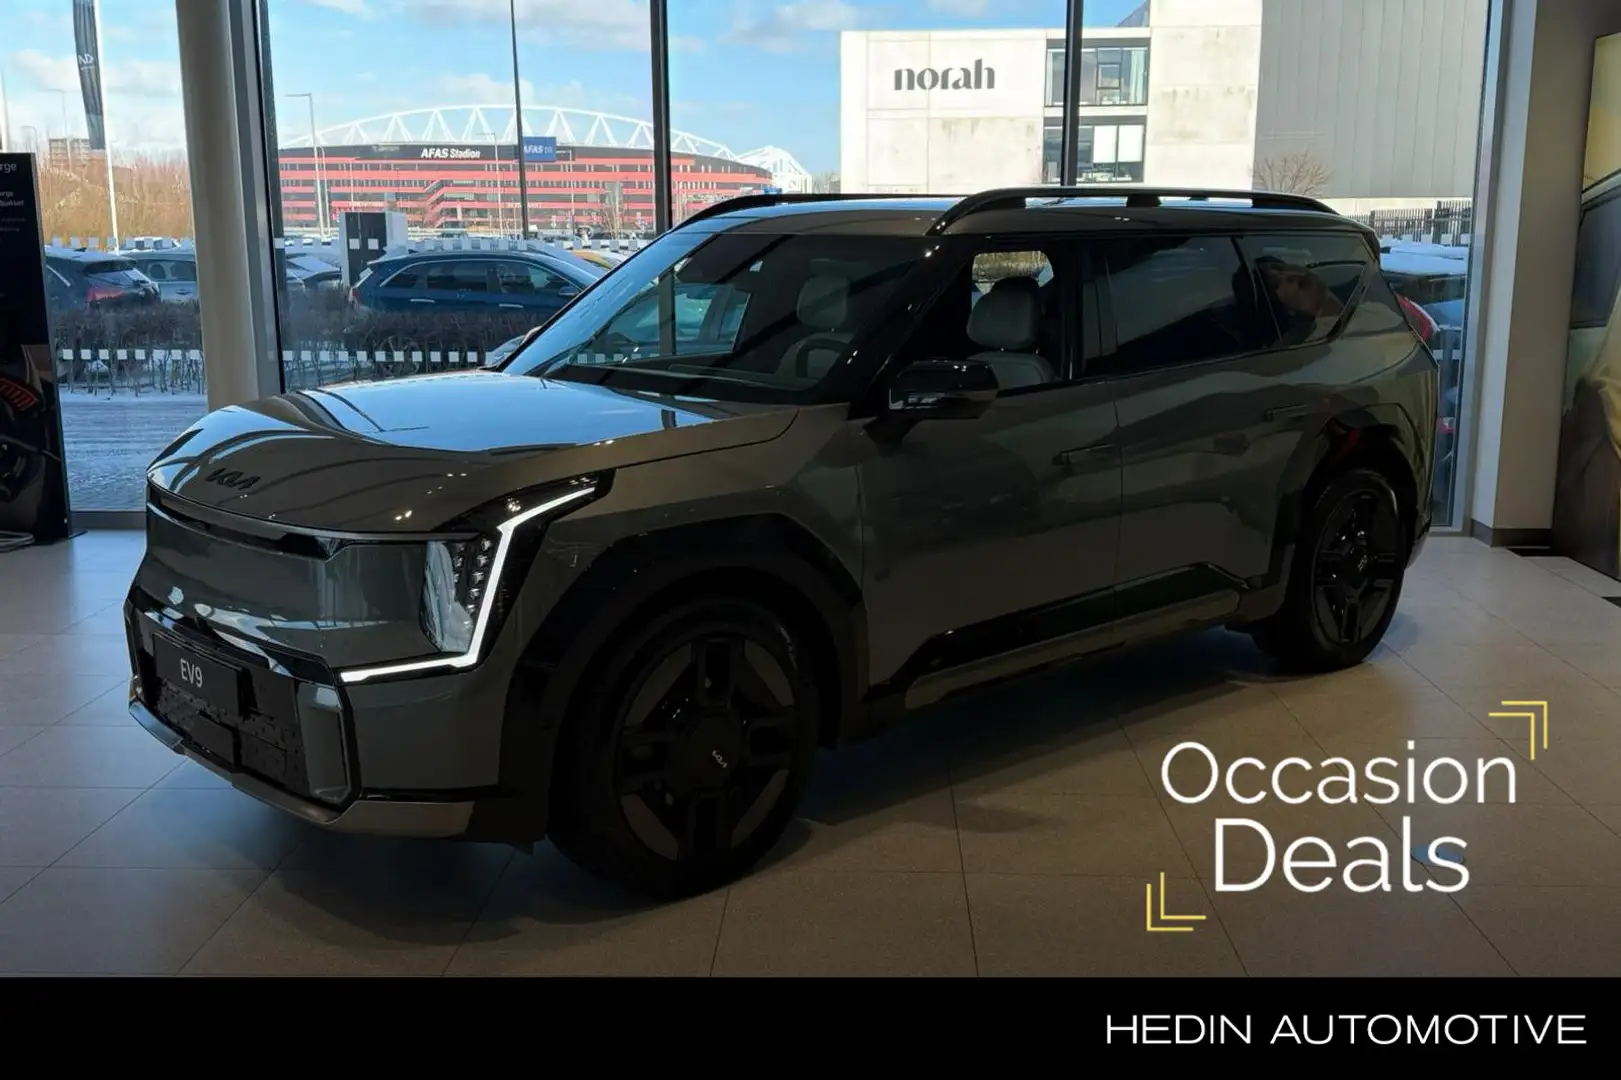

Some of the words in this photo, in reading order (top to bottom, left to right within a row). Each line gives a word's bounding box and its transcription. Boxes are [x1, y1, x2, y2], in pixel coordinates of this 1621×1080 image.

[894, 57, 995, 91] norah
[421, 148, 449, 158] AFAS
[450, 149, 481, 159] Stadion
[180, 658, 203, 688] EV9
